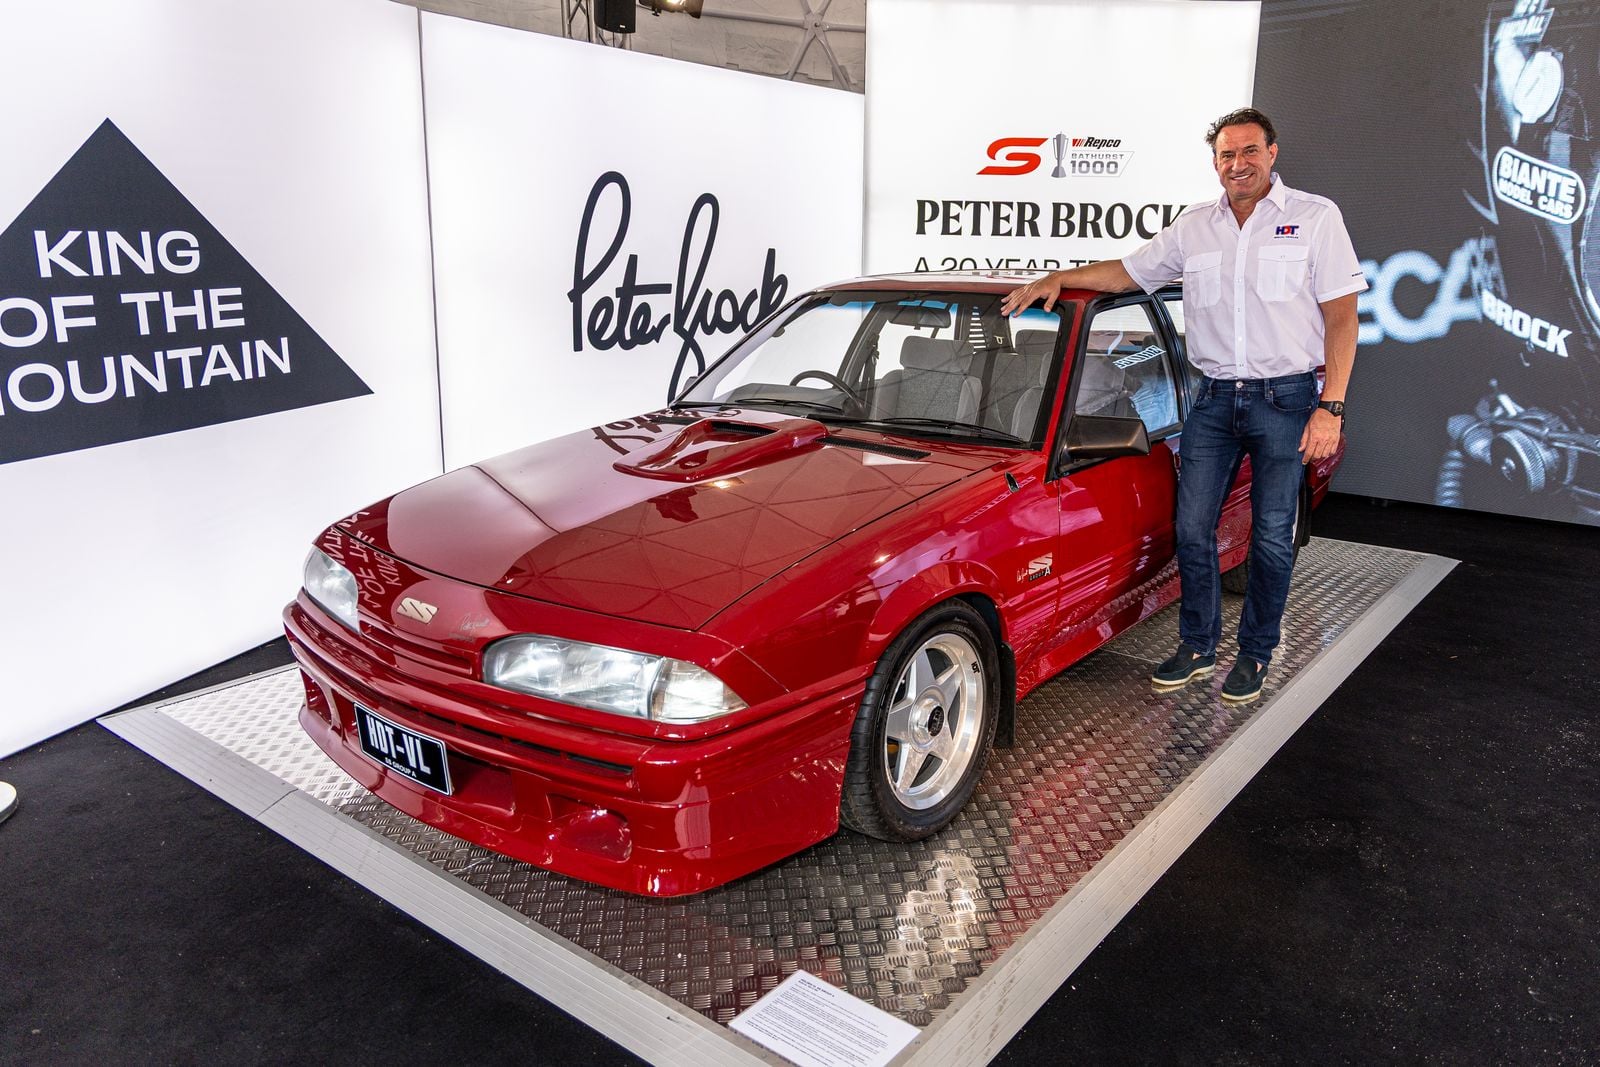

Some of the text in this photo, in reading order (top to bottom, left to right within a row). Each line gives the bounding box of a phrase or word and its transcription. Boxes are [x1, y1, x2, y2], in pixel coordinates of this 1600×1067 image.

[1084, 136, 1122, 150] Repco
[1071, 160, 1119, 175] 1000
[1499, 152, 1577, 204] BIANTE
[915, 199, 1041, 237] PETER
[1498, 177, 1574, 219] MODEL CARS
[1275, 224, 1300, 236] HDT
[33, 230, 201, 279] KING
[567, 170, 673, 353] Peter
[914, 256, 930, 273] A
[0, 287, 246, 349] OF THE
[1482, 288, 1573, 358] BROCK
[0, 336, 292, 416] OUNTAIN
[364, 713, 432, 776] HDT-VL
[392, 761, 412, 775] GROUP
[411, 770, 418, 779] A
